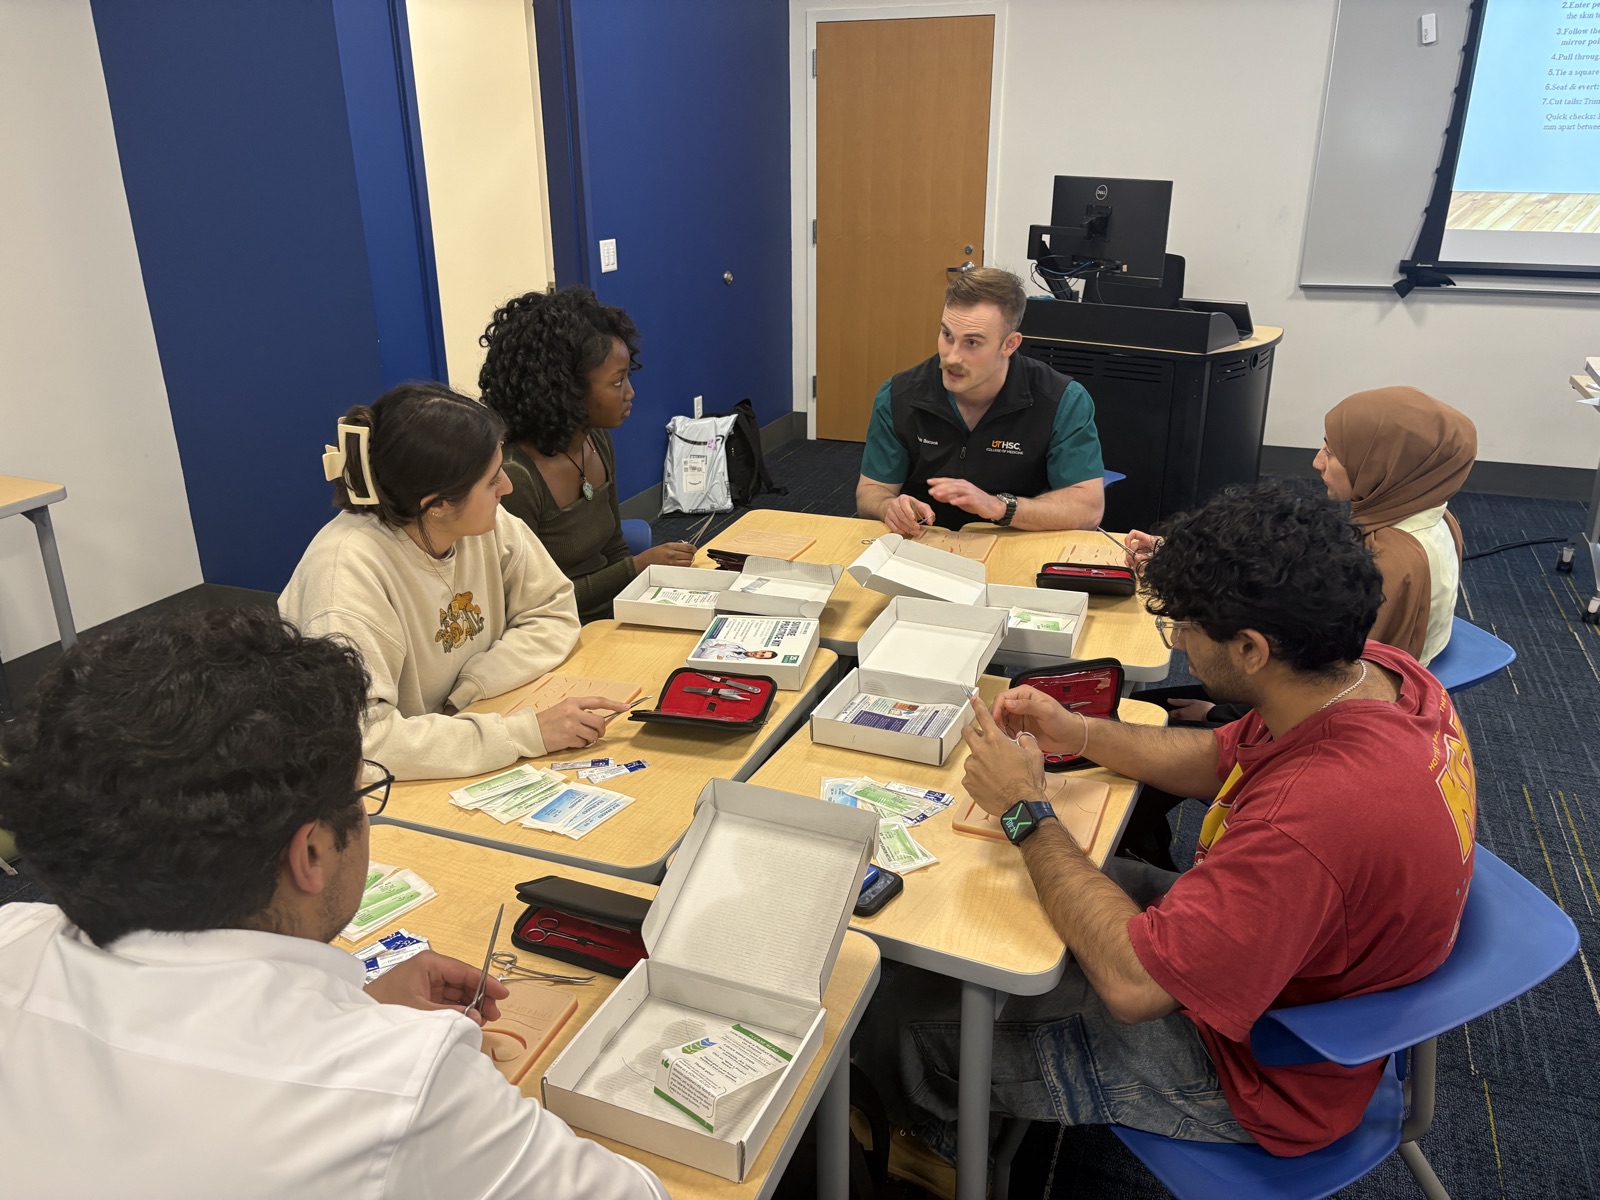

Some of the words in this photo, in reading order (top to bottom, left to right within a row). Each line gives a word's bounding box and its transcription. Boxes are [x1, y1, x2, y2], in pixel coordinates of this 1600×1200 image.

[1546, 113, 1568, 121] Quick
[774, 621, 791, 639] PRACTICE
[786, 621, 801, 636] SUTURE
[598, 808, 613, 818] BRAIDED
[749, 1034, 766, 1045] PLEASE
[765, 1043, 779, 1052] READ
